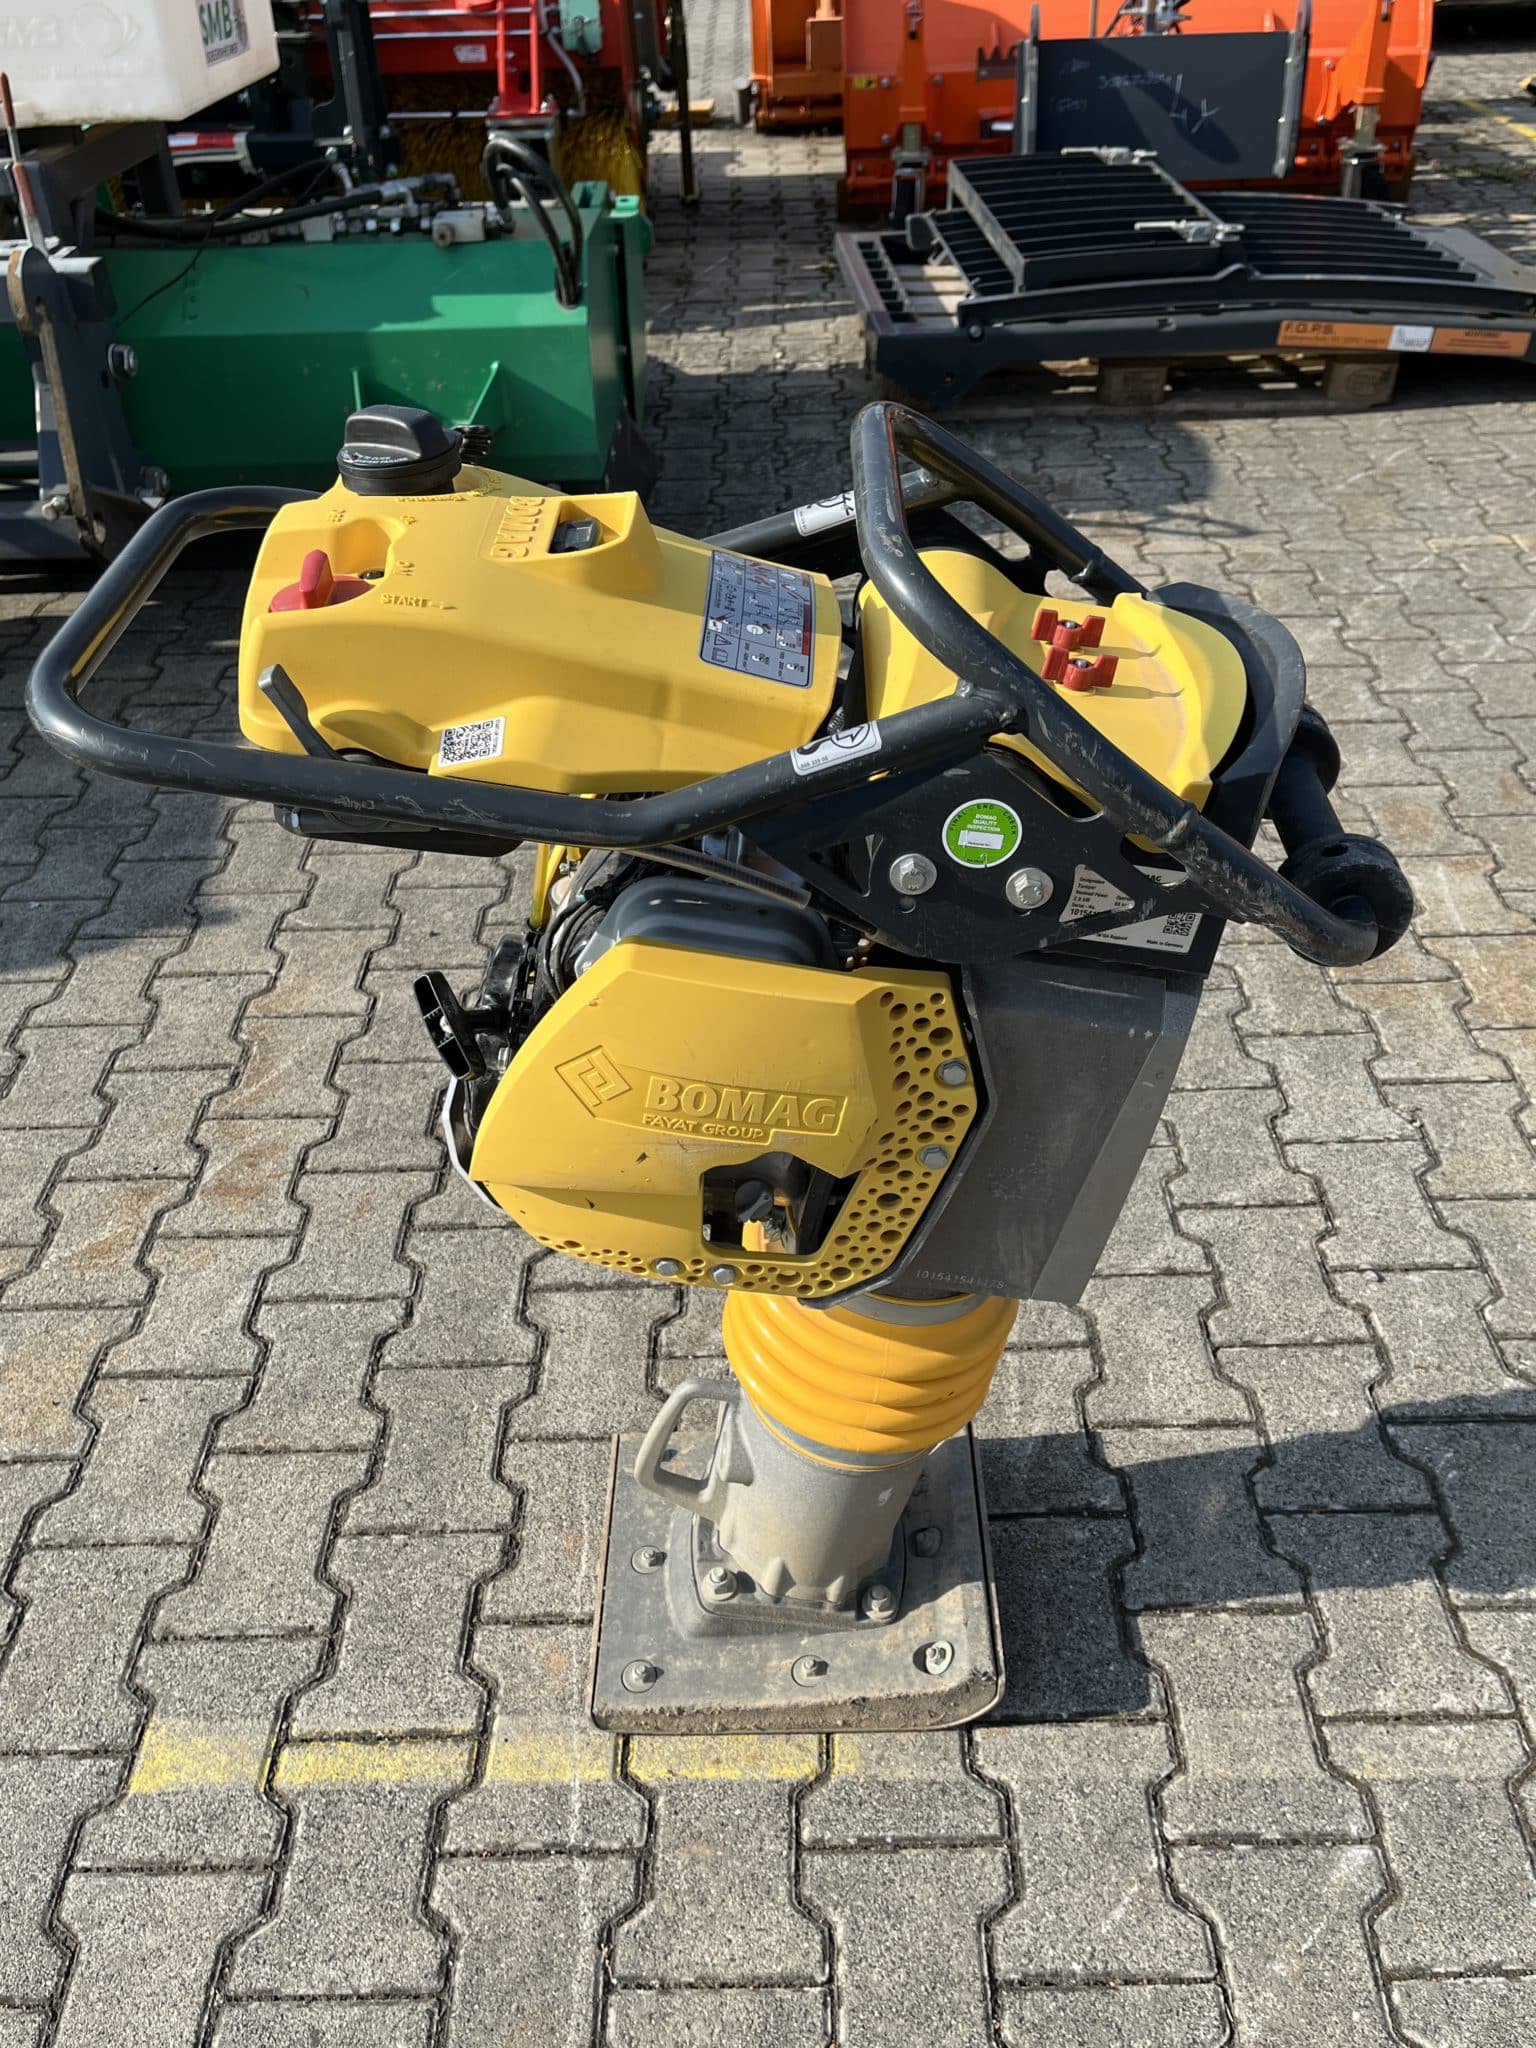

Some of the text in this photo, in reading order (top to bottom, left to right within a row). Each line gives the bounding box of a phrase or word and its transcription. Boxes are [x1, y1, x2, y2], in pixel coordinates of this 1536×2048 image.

[380, 593, 428, 609] START
[645, 1075, 838, 1130] BOMAG
[641, 1112, 764, 1141] FAYAT GROUP
